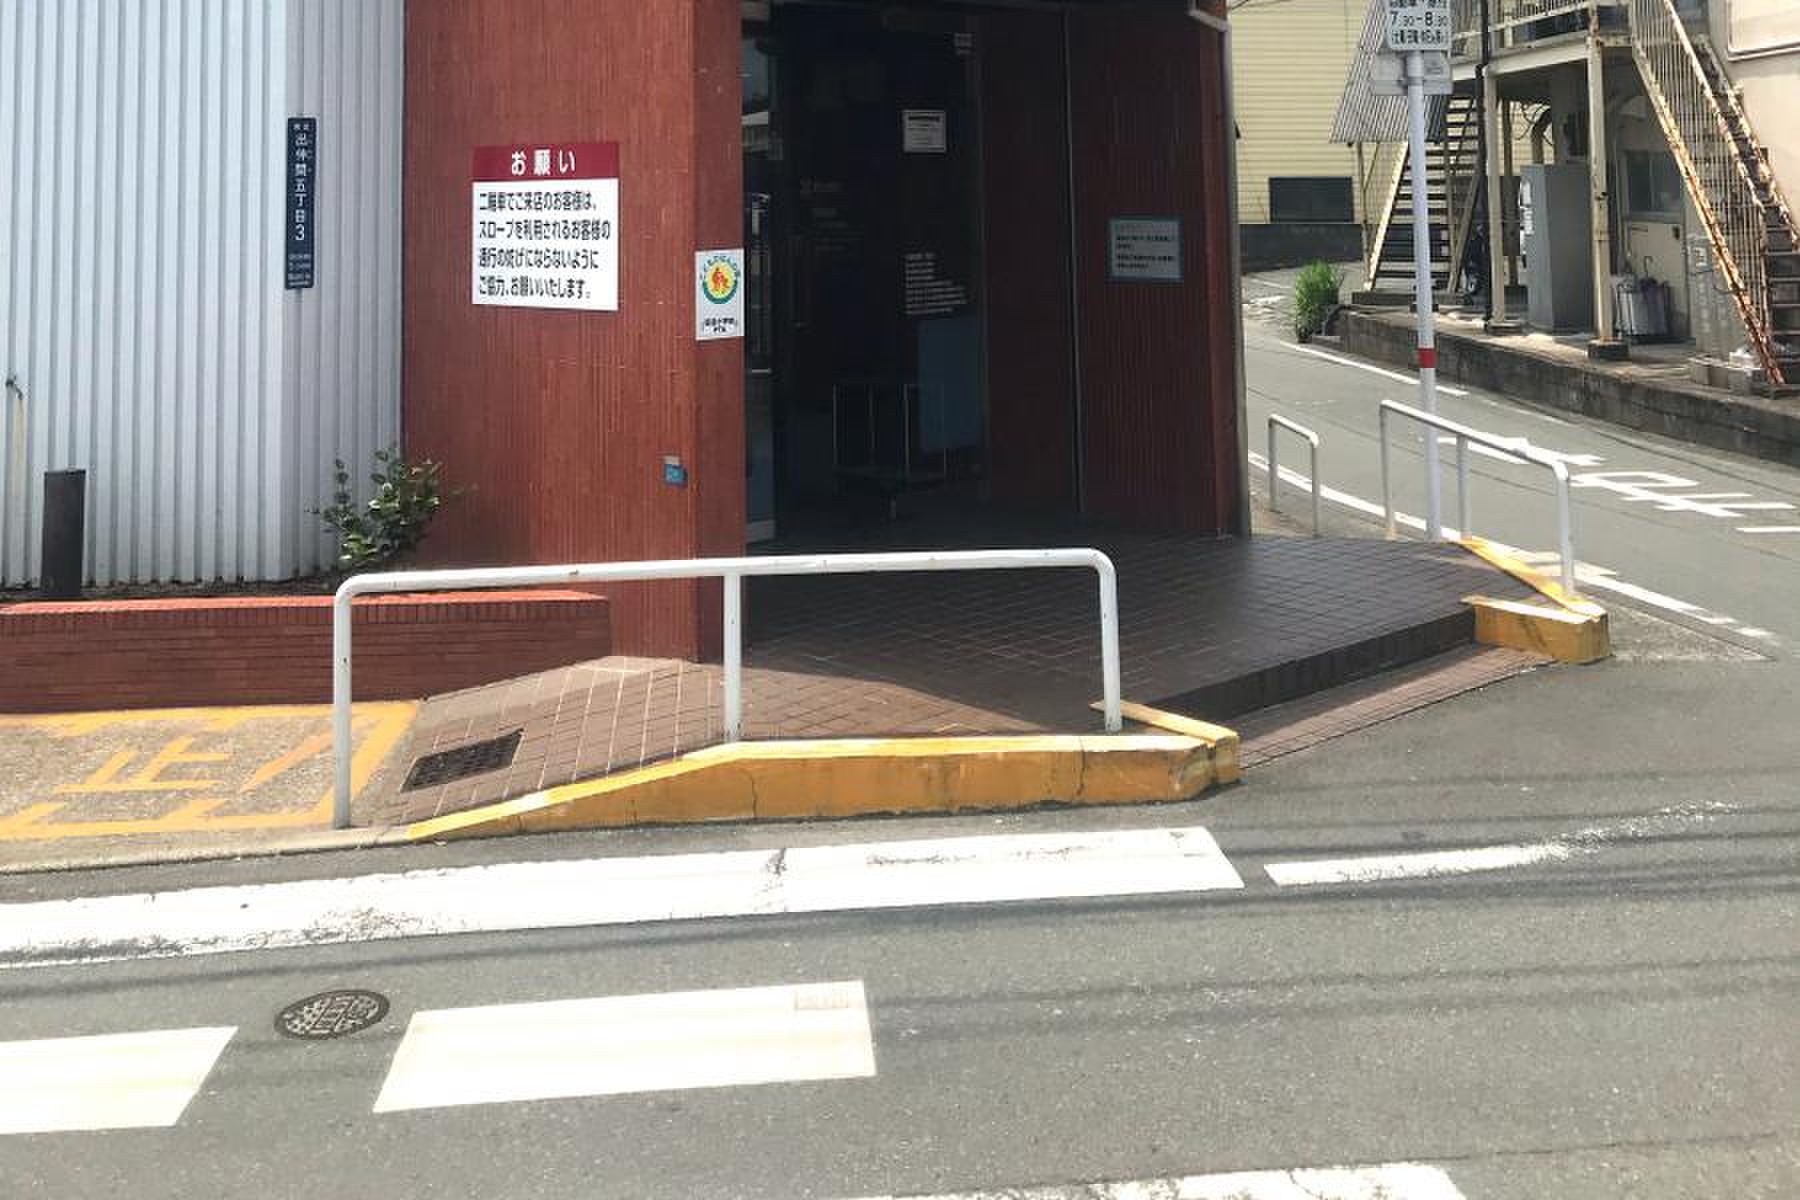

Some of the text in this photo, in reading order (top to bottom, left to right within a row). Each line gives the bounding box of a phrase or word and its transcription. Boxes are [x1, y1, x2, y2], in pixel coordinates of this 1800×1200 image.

[511, 148, 576, 176] お願い
[479, 218, 611, 241] スロープを利用されるお客様の
